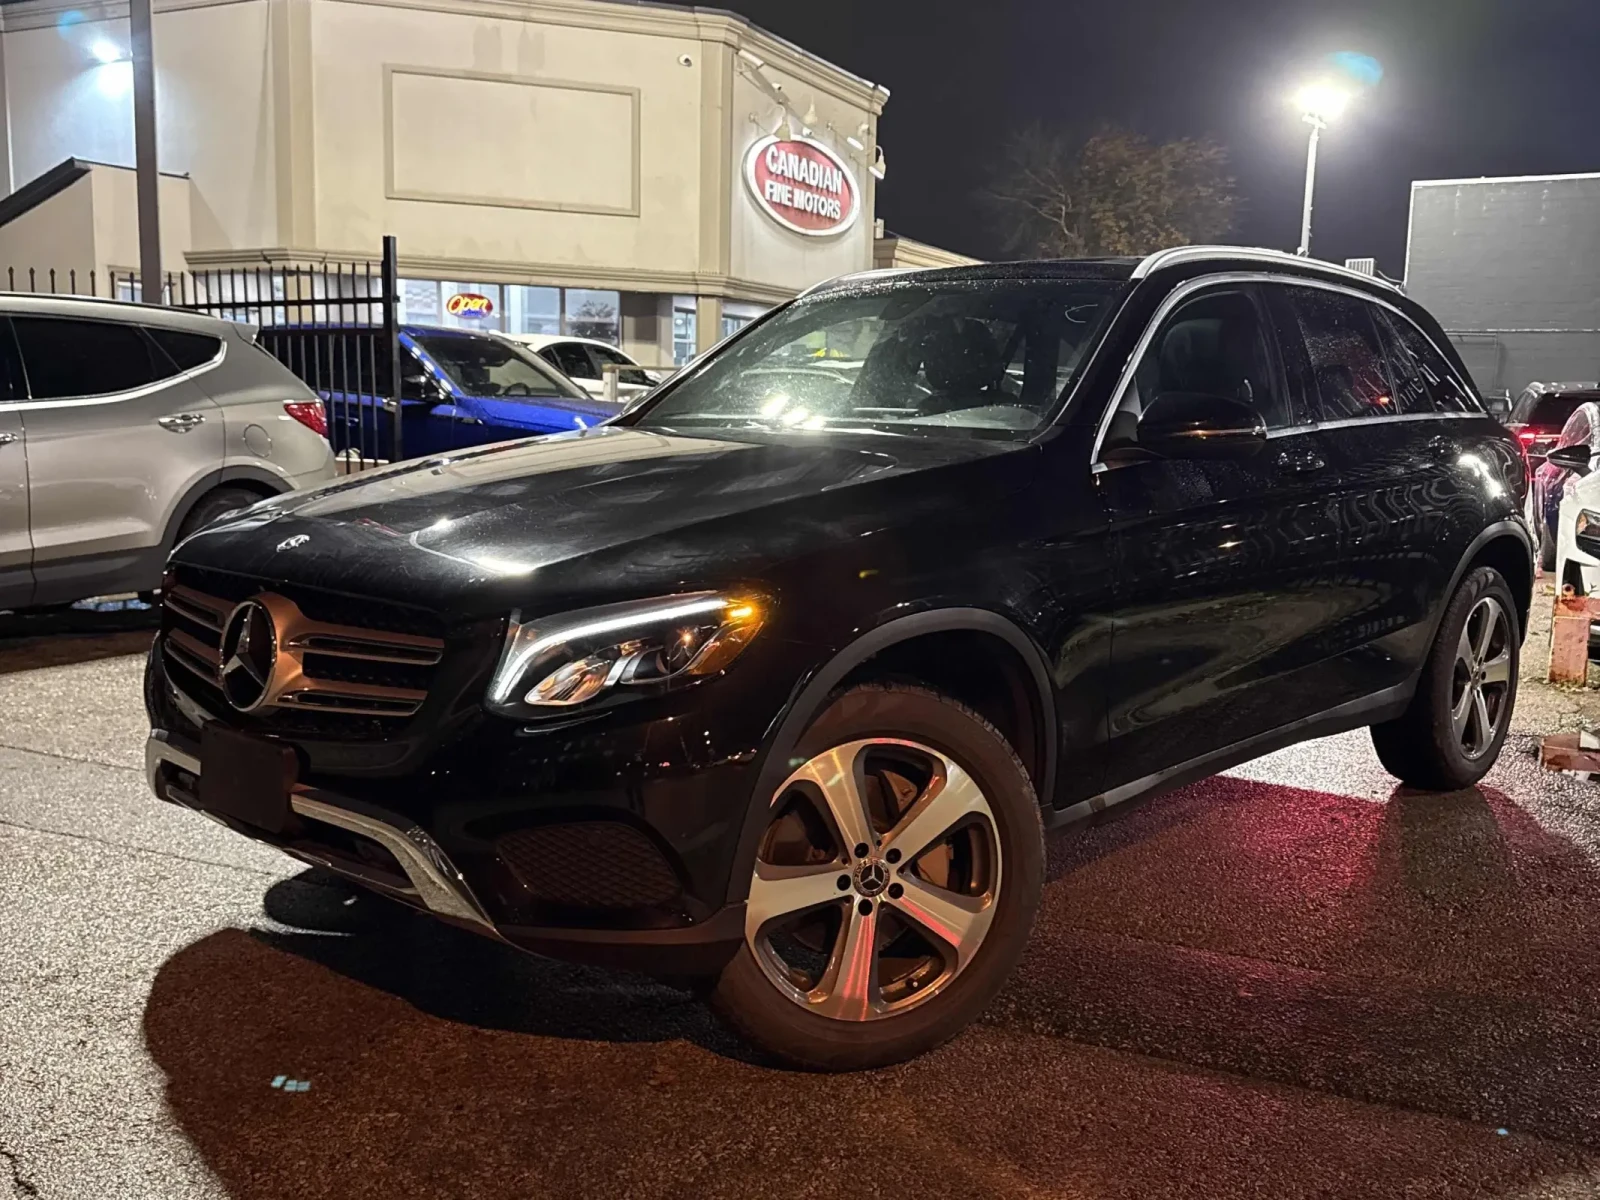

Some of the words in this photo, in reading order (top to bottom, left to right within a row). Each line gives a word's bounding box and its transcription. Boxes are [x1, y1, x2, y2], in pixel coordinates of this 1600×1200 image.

[766, 144, 842, 194] CANADIAN
[764, 179, 793, 206] FINE
[793, 188, 841, 220] MOTORS
[448, 295, 488, 313] Open
